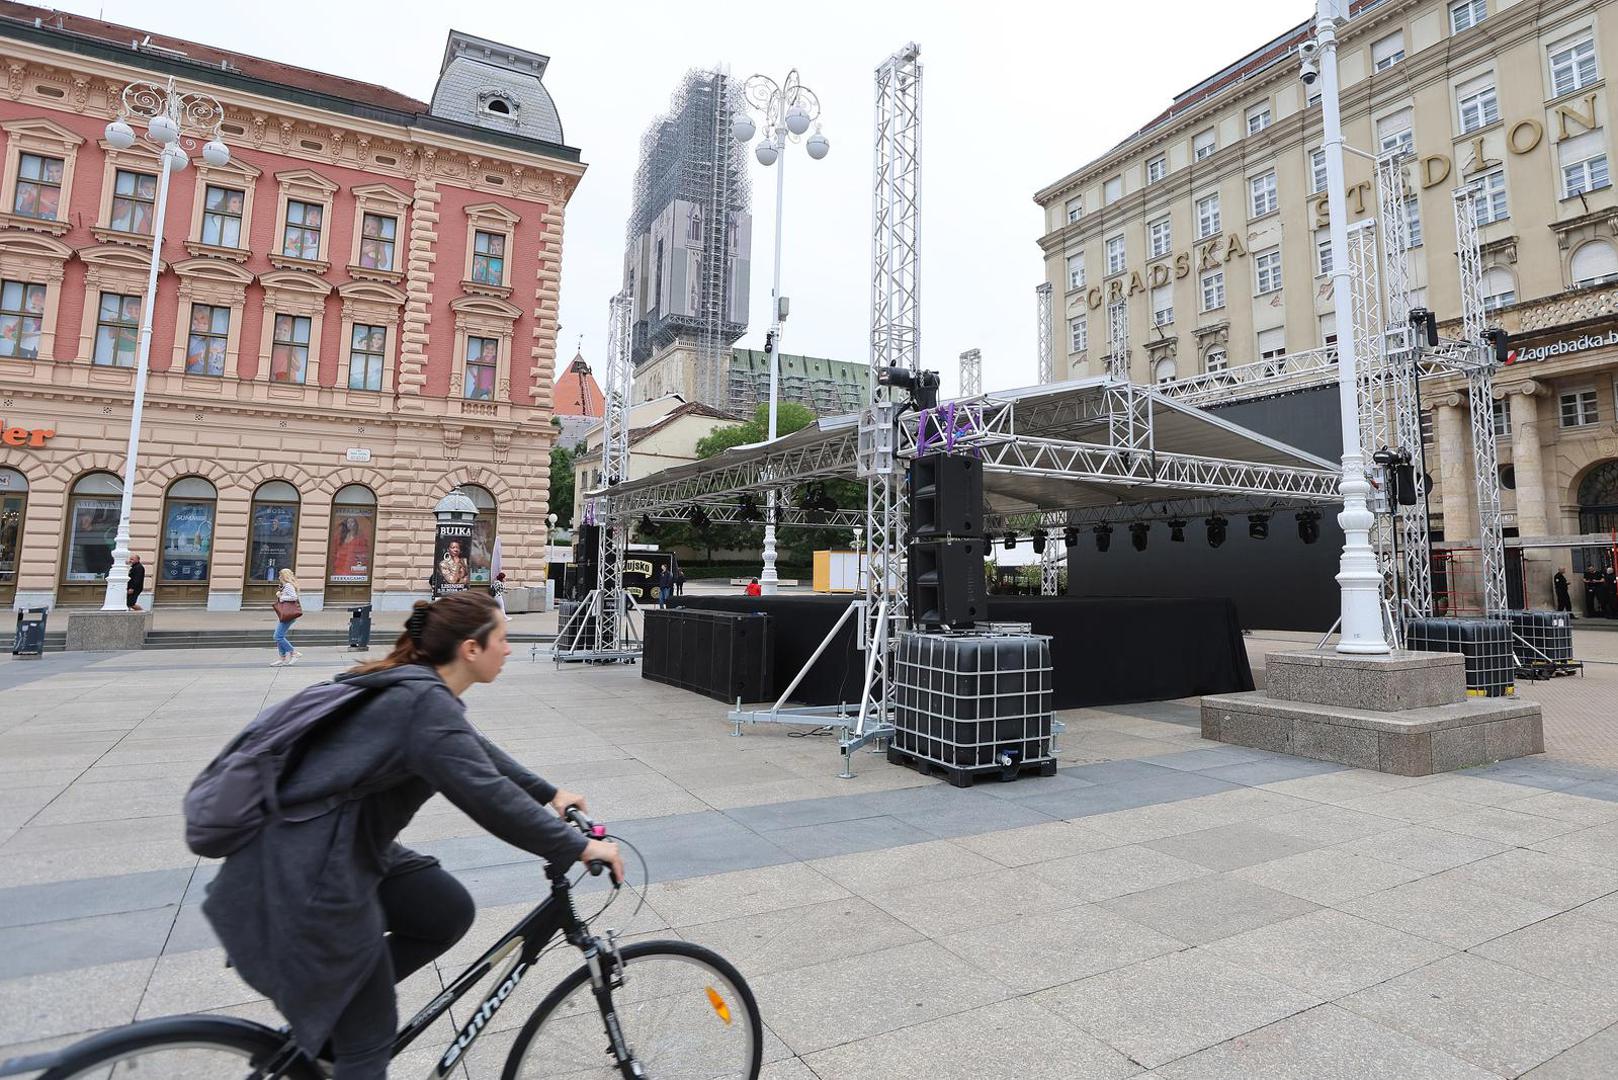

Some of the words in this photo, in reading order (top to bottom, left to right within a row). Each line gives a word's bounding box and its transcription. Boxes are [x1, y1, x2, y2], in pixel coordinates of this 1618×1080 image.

[1087, 233, 1247, 310] GRADSKA
[1517, 334, 1604, 361] Zagrebačka
[0, 418, 56, 448] er
[440, 526, 472, 536] BUIKA
[443, 962, 527, 1068] author
